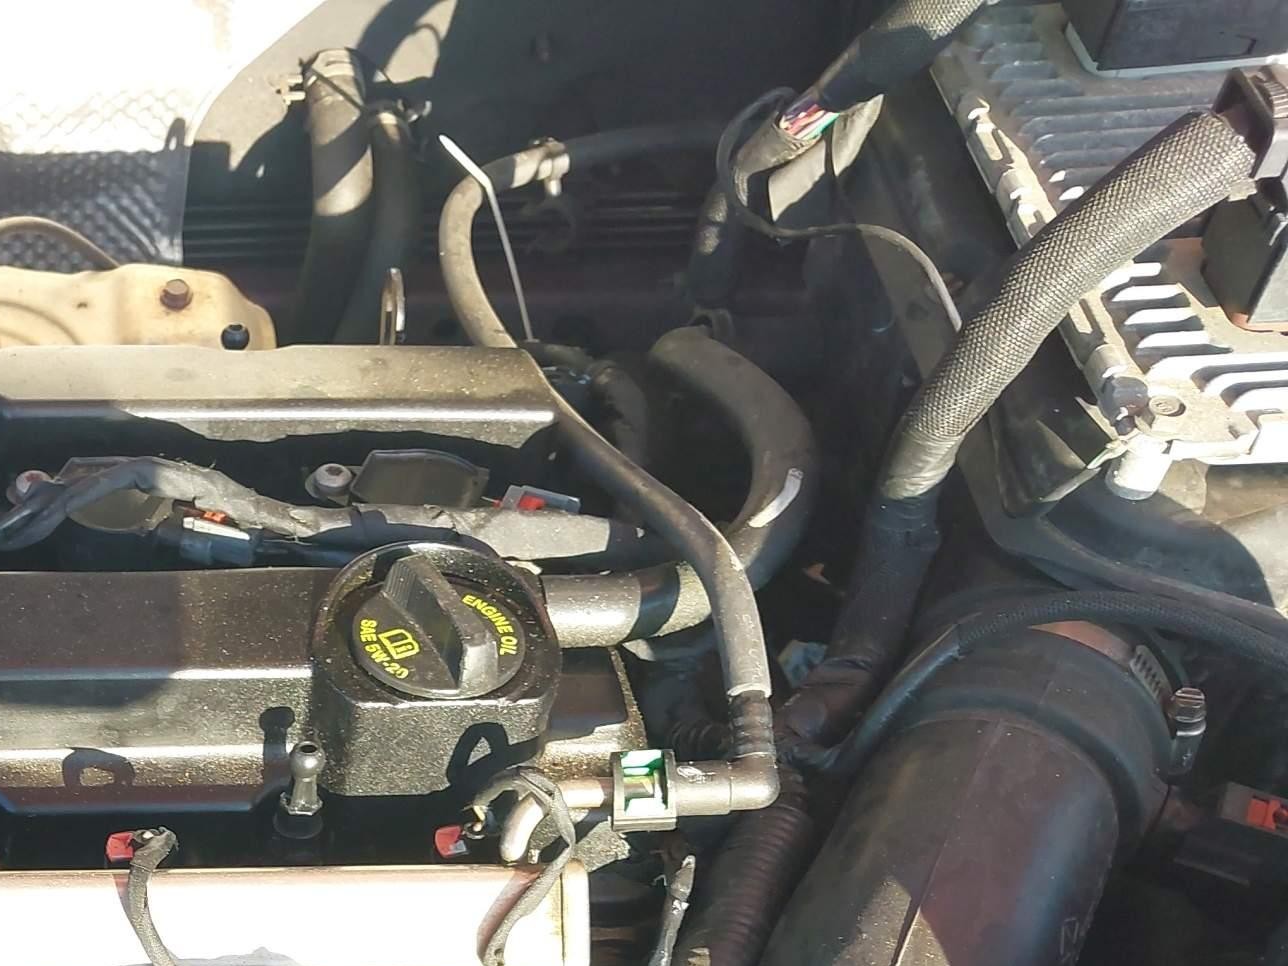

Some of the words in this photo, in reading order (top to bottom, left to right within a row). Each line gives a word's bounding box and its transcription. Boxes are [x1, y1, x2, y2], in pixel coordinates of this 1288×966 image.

[359, 619, 378, 643] SAE
[462, 594, 514, 639] ENGINE
[499, 636, 519, 656] OIL
[364, 643, 410, 680] 5W-20
